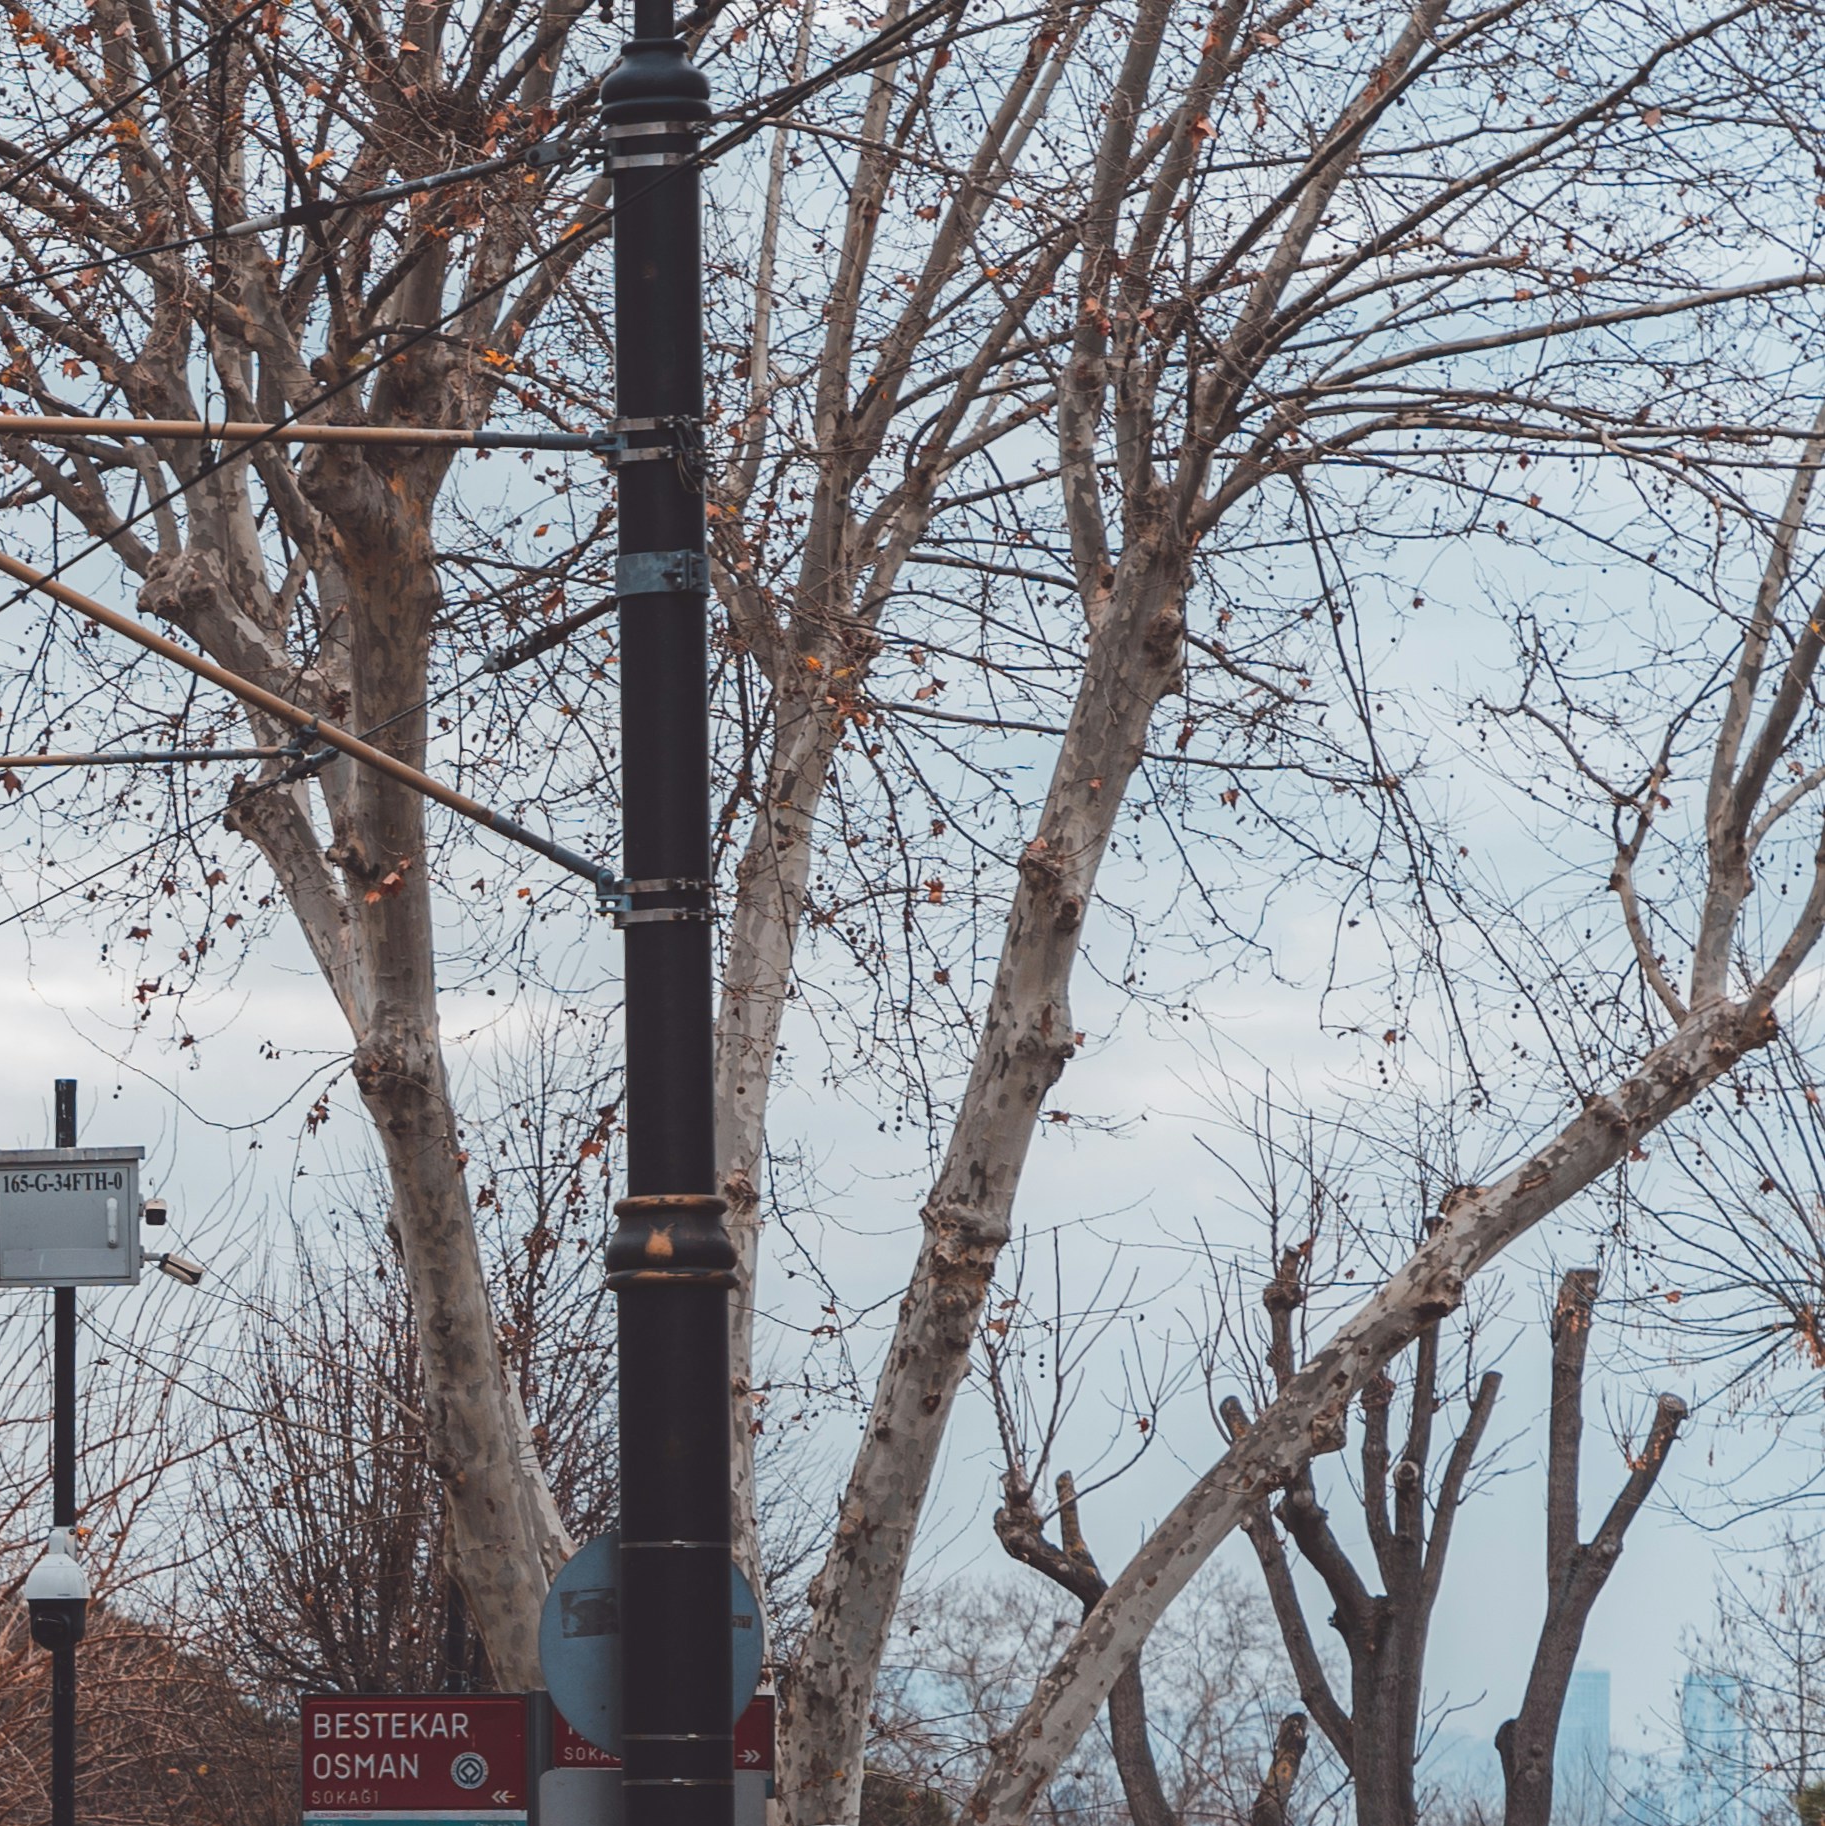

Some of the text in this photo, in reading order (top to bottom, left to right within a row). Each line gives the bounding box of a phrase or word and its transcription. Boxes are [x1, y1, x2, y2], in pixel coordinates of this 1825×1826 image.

[2, 1171, 123, 1193] 165-G-34FTH-0
[313, 1713, 470, 1740] BESTEKAR
[313, 1753, 420, 1780] OSMAN
[311, 1788, 379, 1805] SOKAĞI
